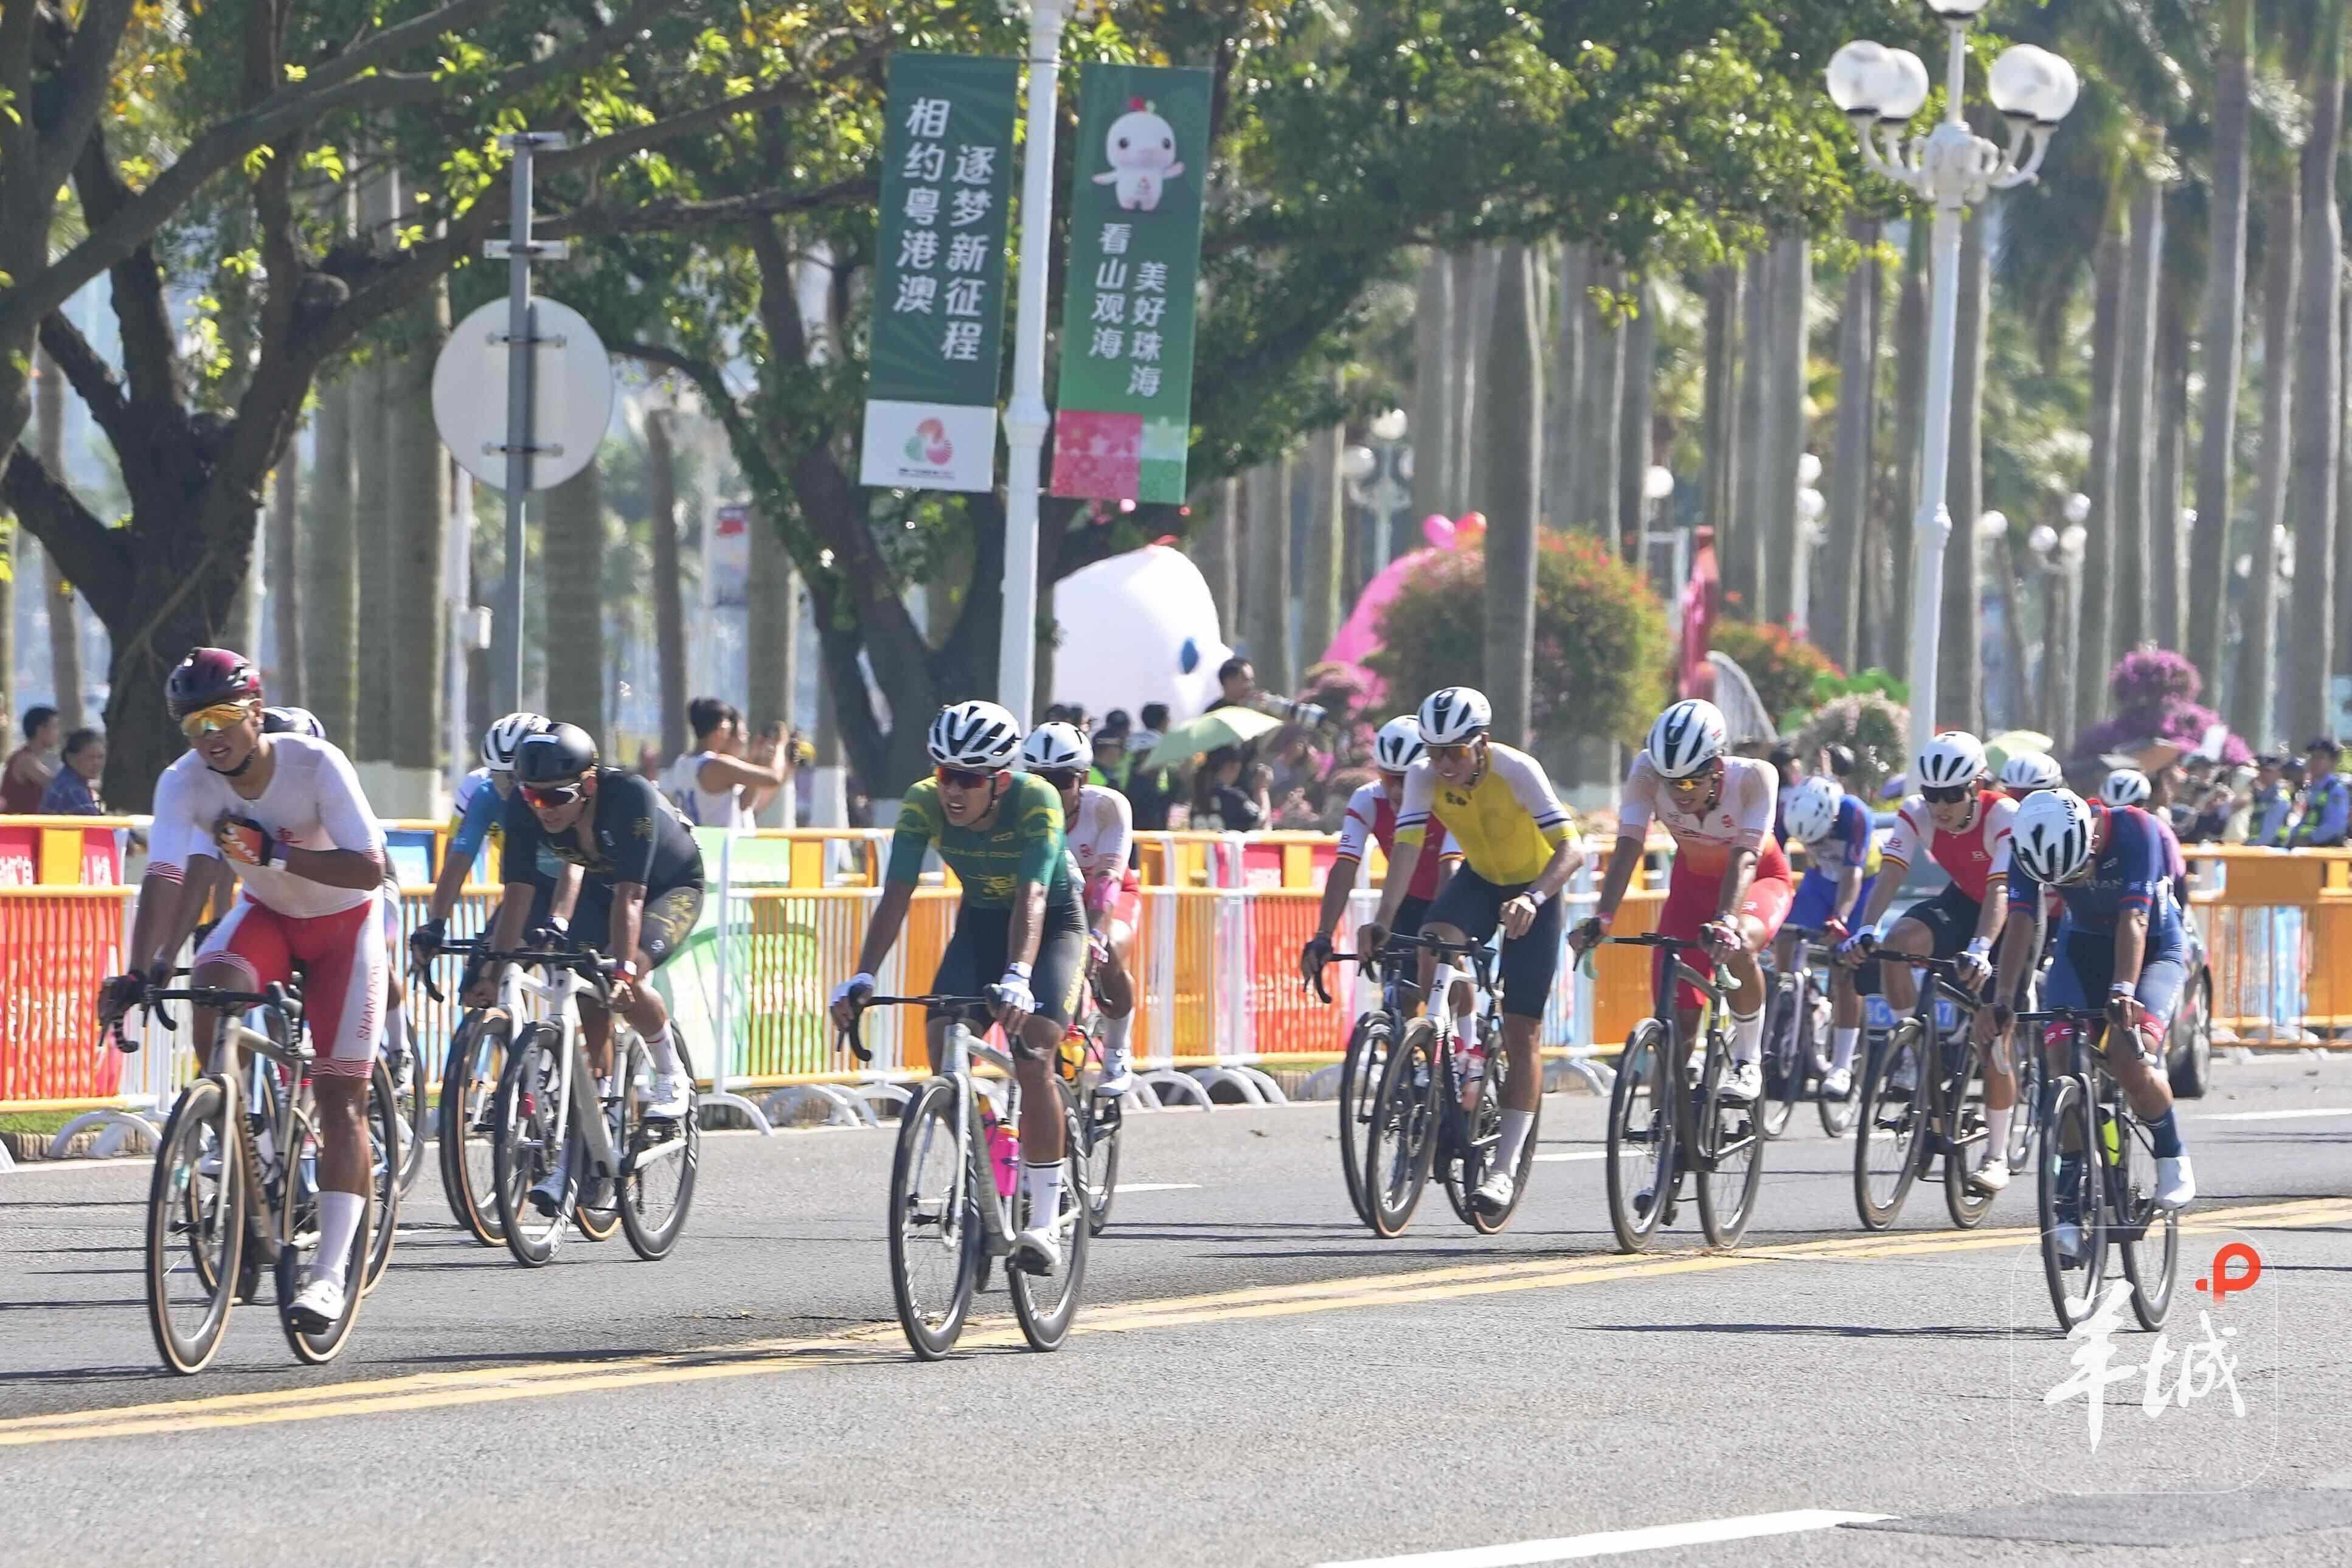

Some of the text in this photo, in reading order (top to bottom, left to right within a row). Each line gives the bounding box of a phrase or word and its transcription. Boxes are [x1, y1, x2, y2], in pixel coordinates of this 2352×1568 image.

[892, 97, 950, 315] 相约粤港澳
[941, 145, 996, 361] 逐梦新征程
[1088, 223, 1133, 359] 看山观海
[1127, 262, 1168, 398] 美好珠海
